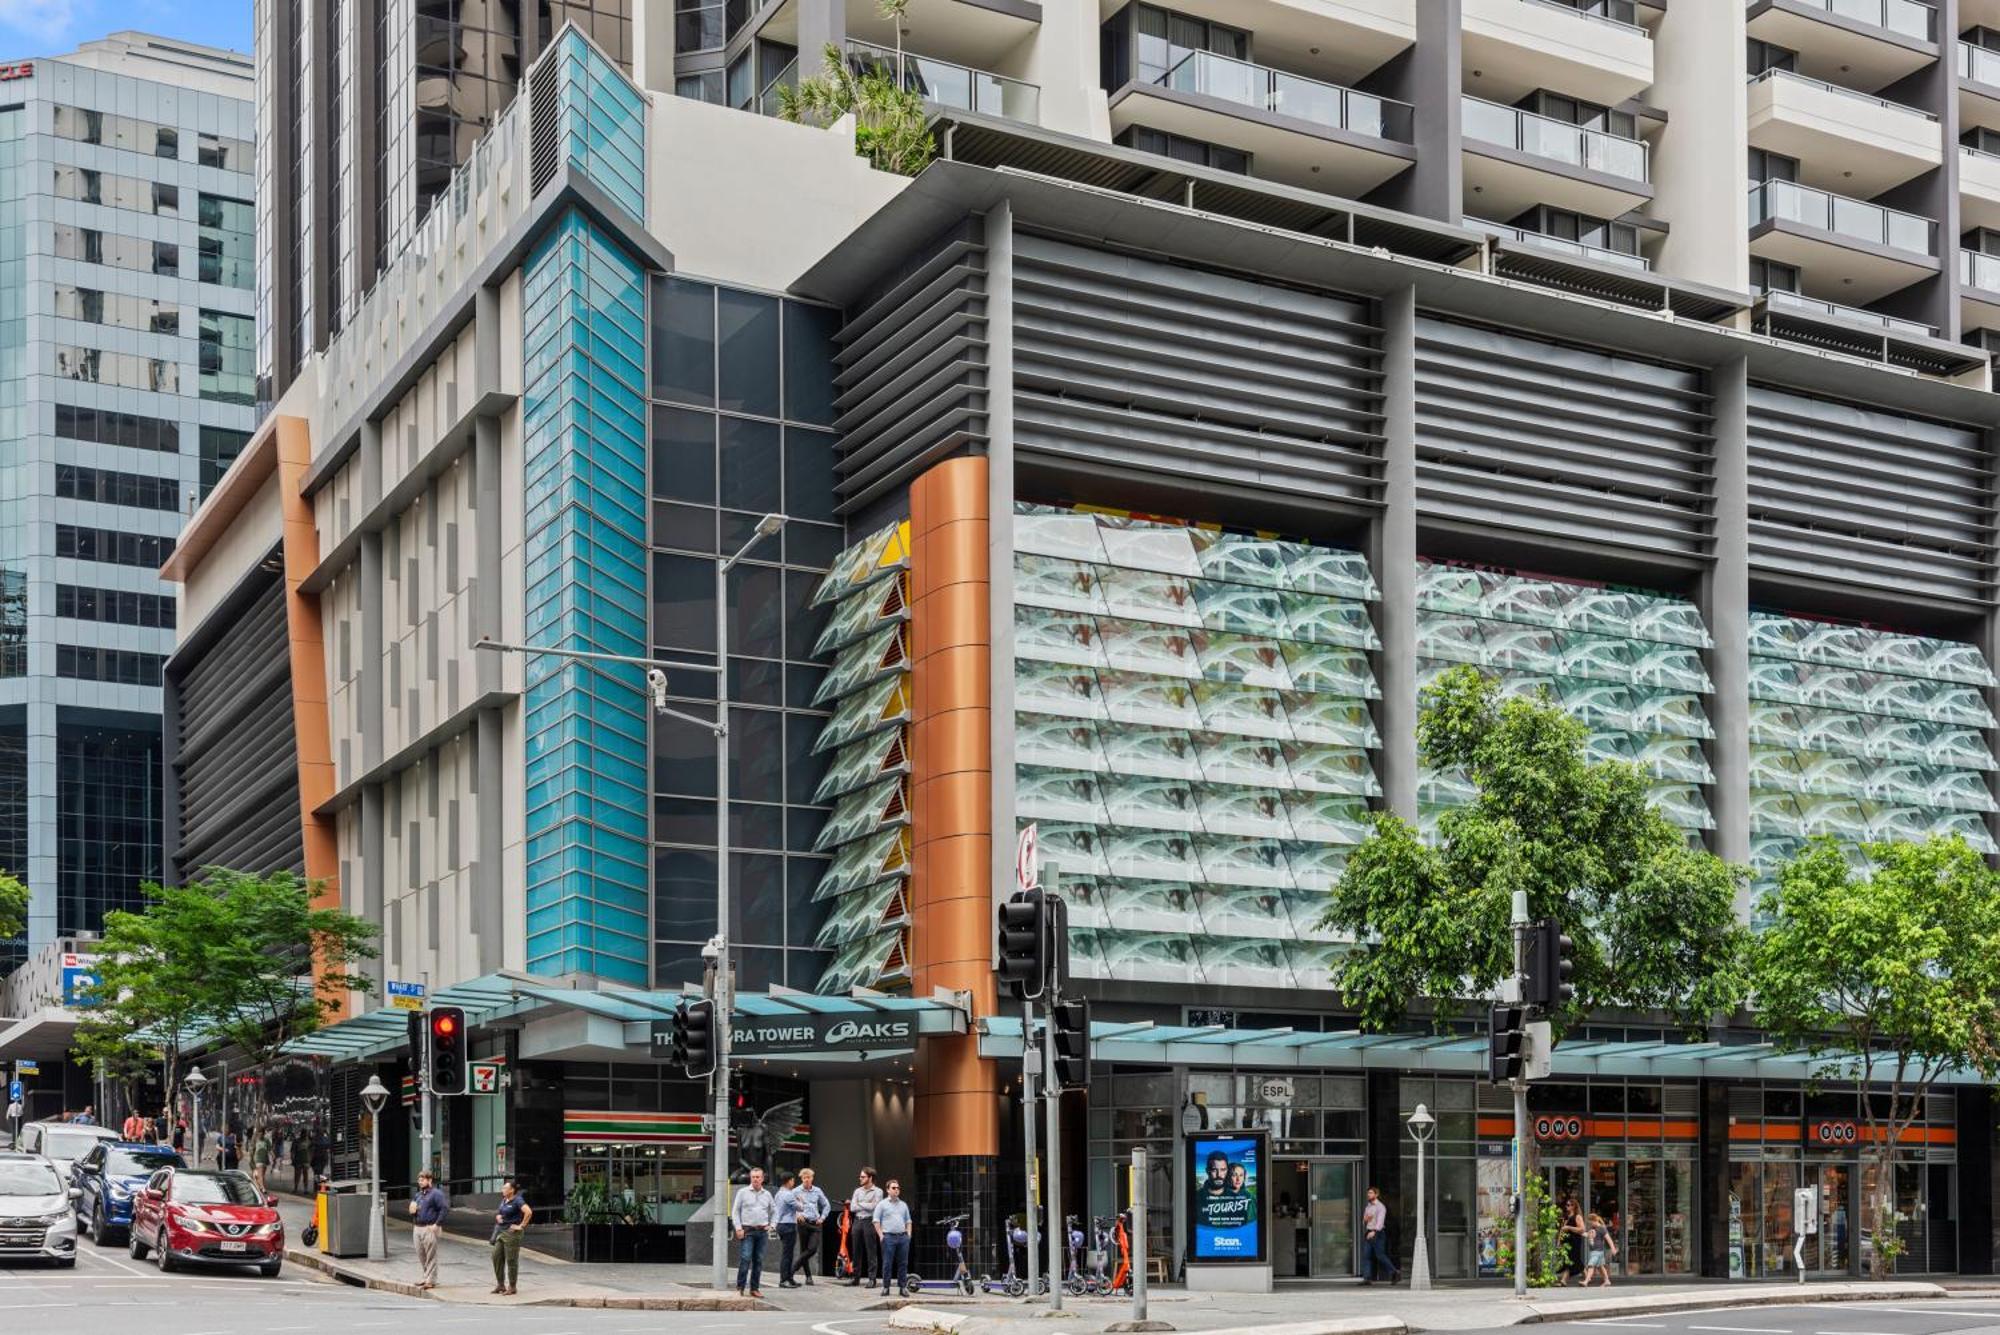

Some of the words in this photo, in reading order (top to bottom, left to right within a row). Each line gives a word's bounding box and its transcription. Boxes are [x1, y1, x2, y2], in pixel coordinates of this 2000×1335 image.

[757, 1027, 815, 1041] TOWER
[825, 1021, 909, 1043] OAKS
[1540, 1122, 1577, 1133] BWS
[1823, 1128, 1852, 1137] BWS
[1208, 1199, 1251, 1216] TOURIST
[1213, 1237, 1242, 1247] Stan.
